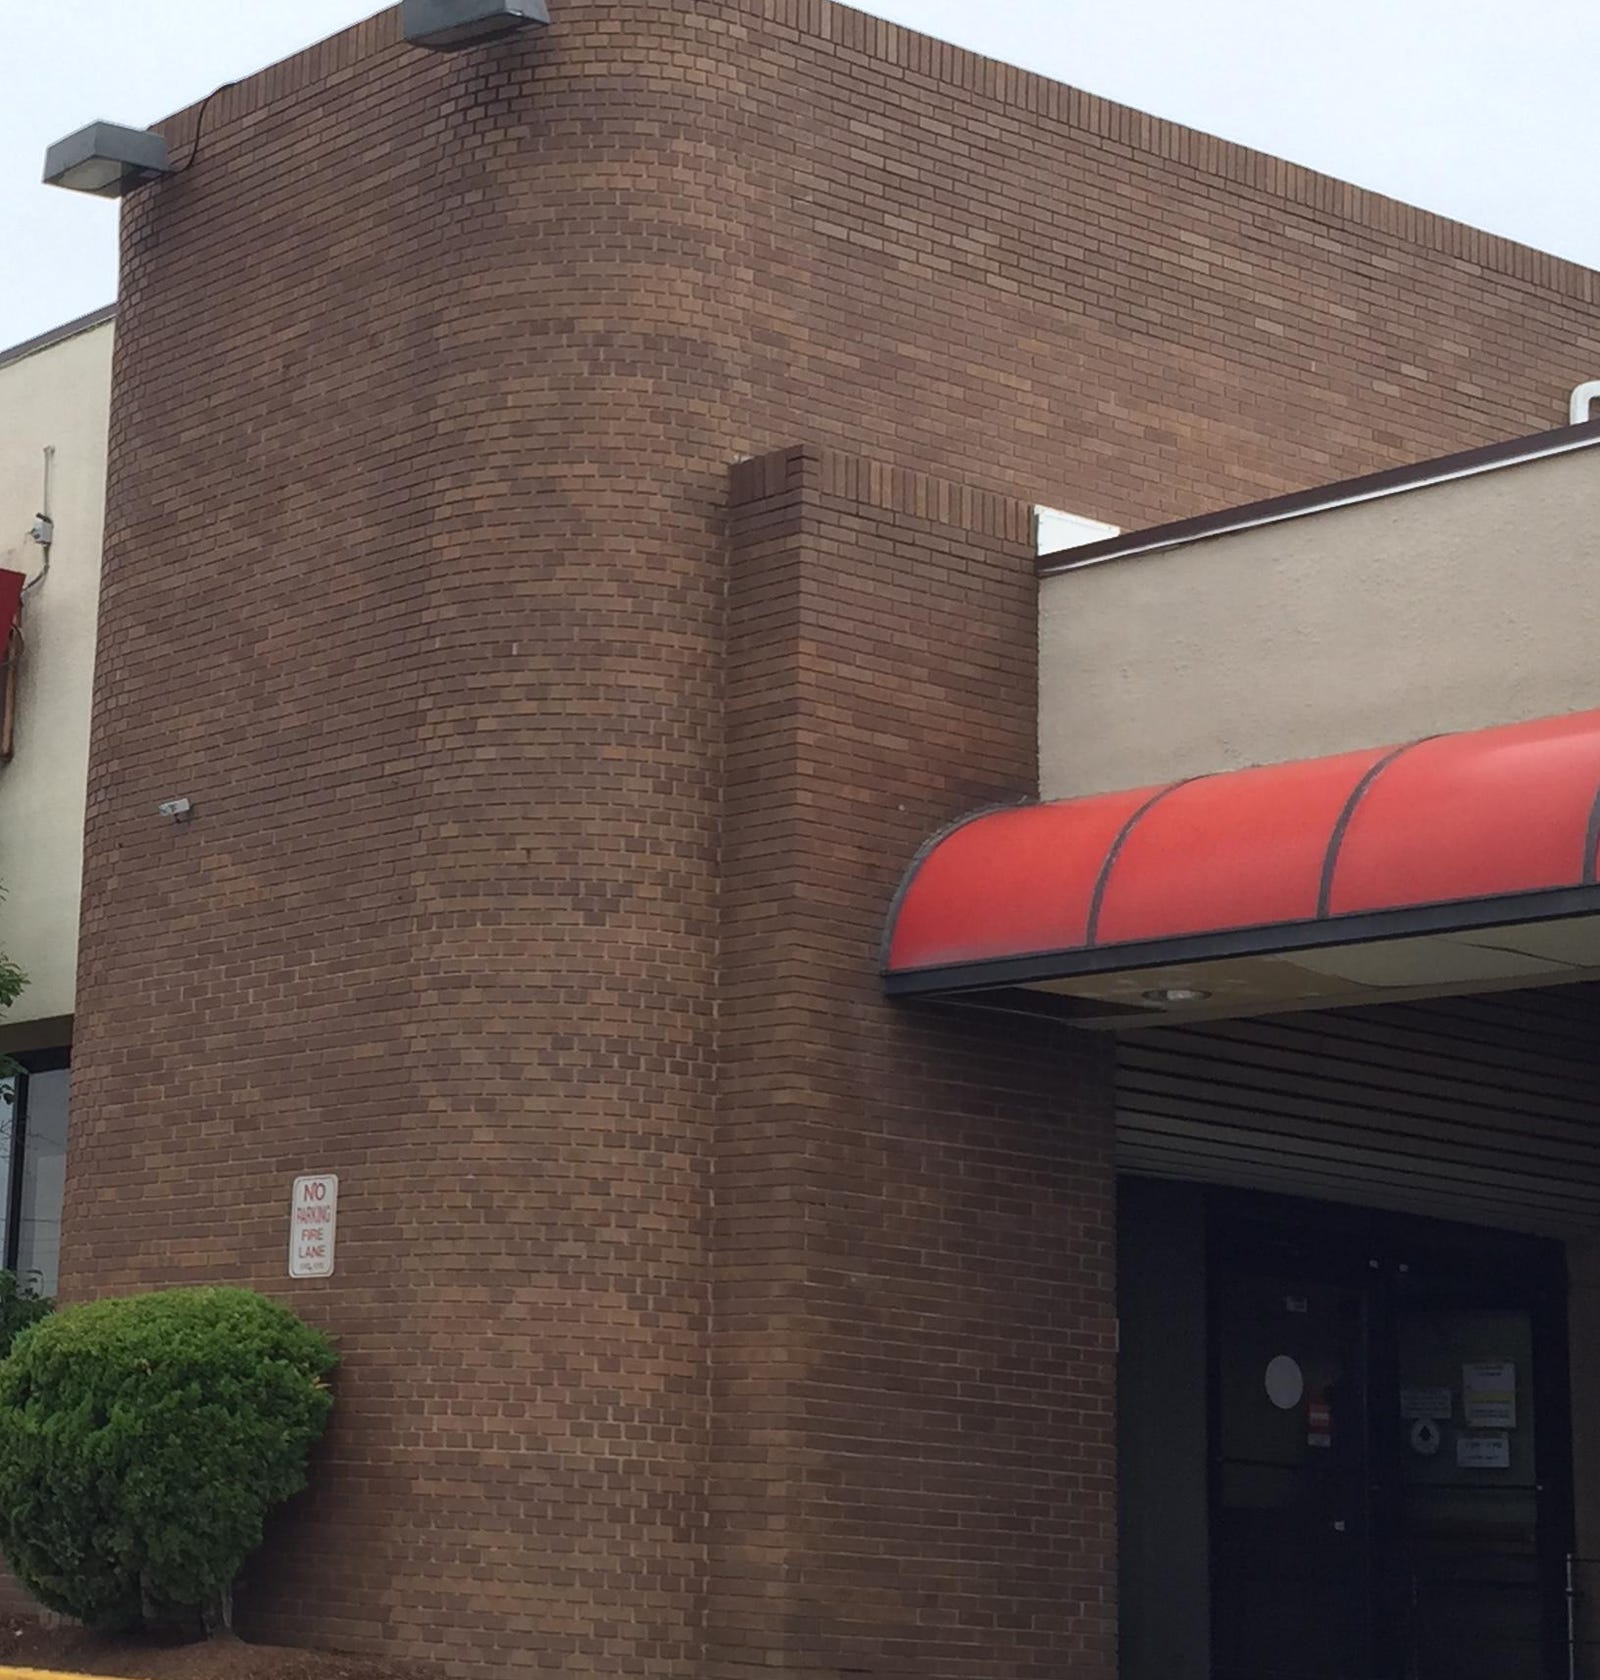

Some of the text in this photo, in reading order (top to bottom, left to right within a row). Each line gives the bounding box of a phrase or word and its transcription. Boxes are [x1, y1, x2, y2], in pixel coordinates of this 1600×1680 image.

[303, 1182, 326, 1201] NO
[296, 1204, 331, 1224] PARKING
[301, 1227, 324, 1241] FIRE
[298, 1244, 327, 1259] LANE
